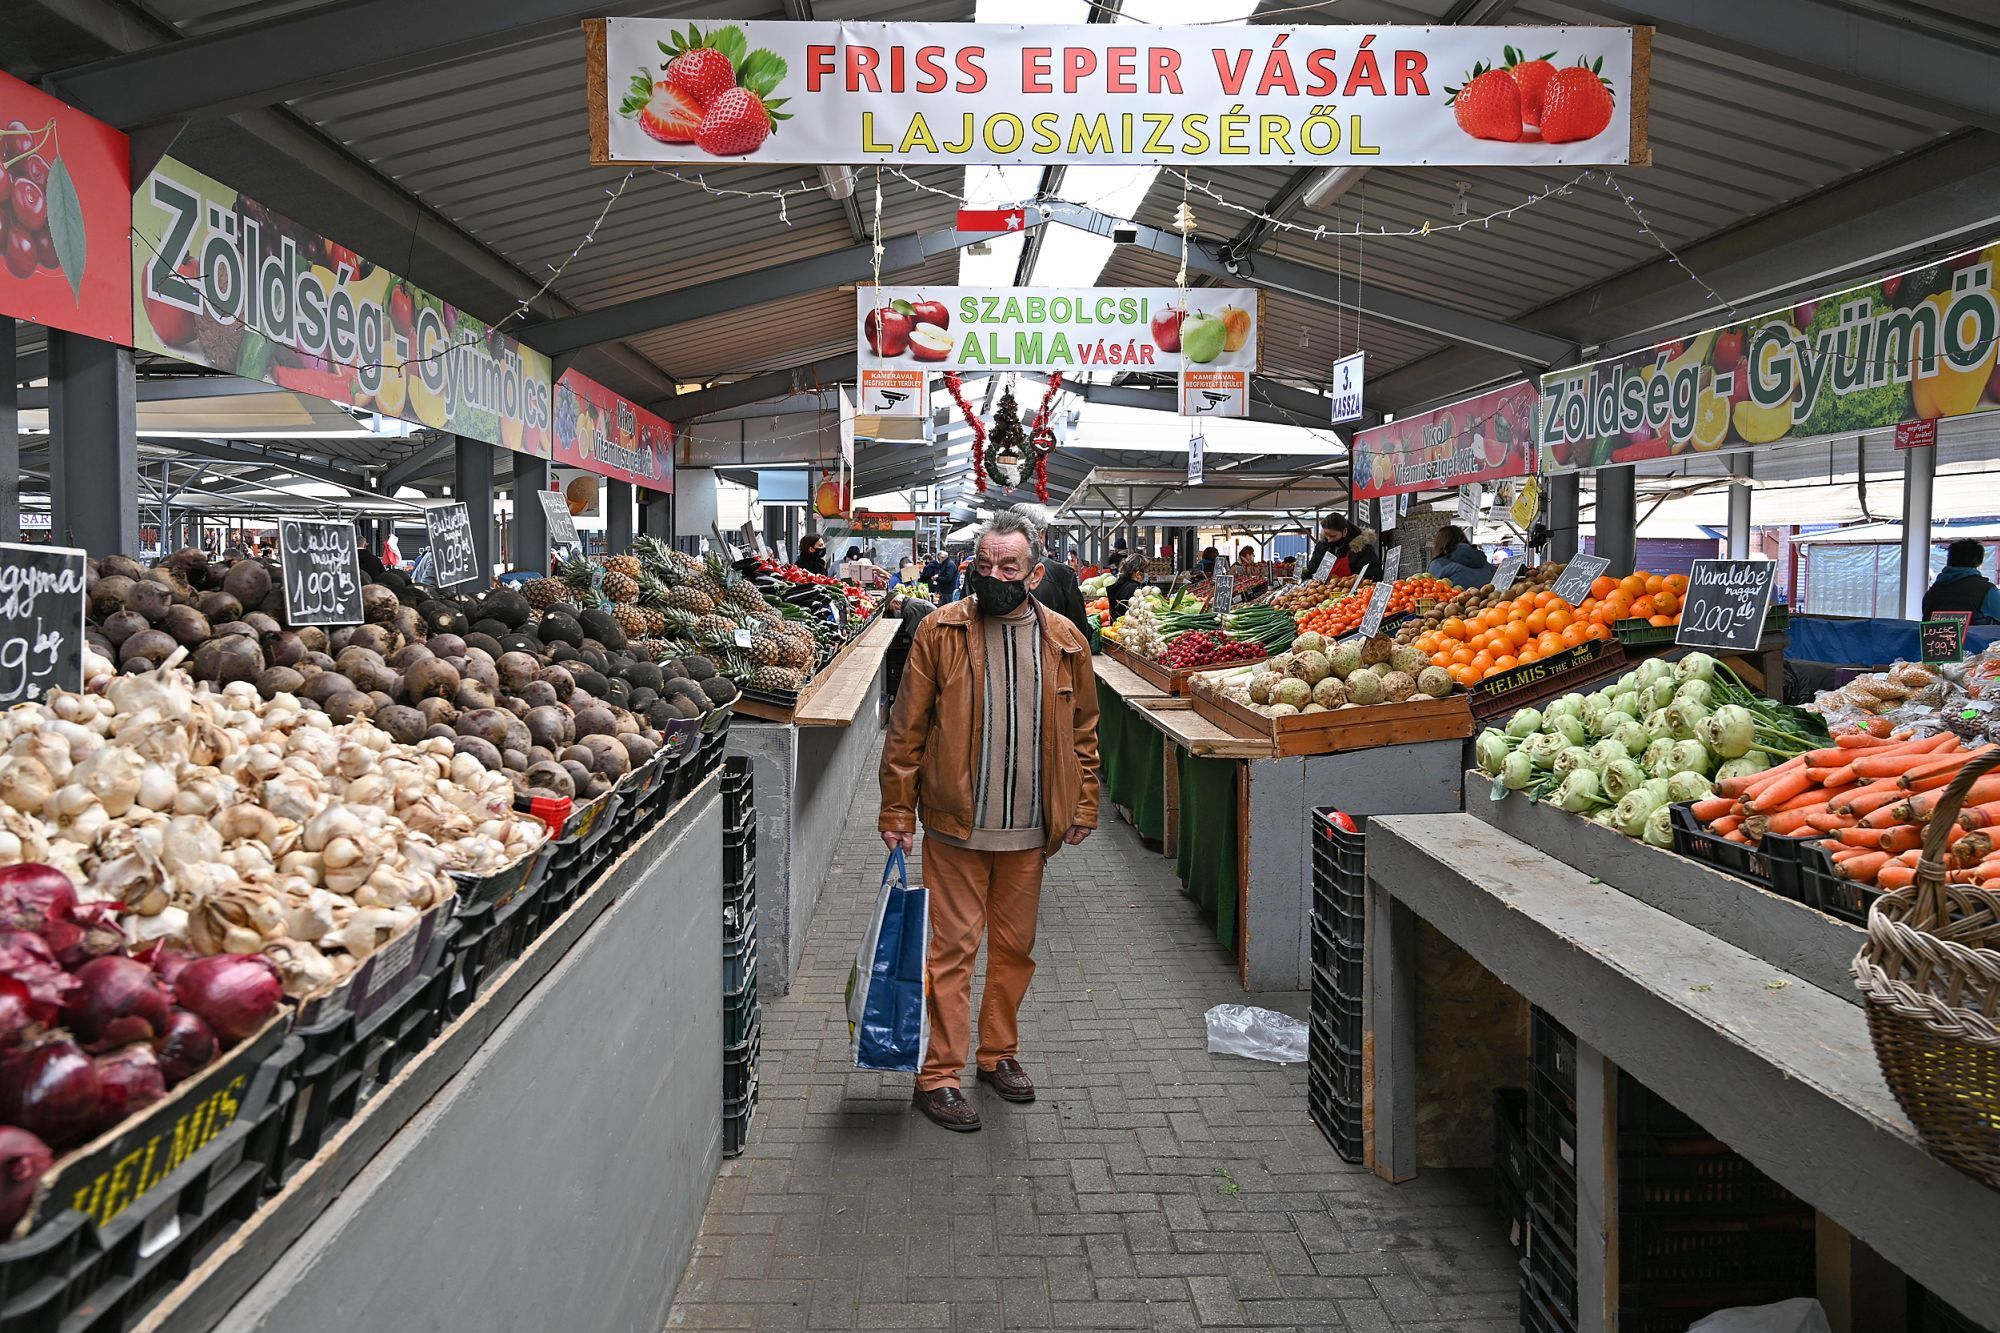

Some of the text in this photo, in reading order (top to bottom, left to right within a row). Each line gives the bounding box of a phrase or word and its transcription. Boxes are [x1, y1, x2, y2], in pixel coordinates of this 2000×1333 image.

[806, 34, 1430, 96] FRISS EPER VÁSÁR
[862, 104, 1380, 155] LAJOSMIZSÉRŐL
[147, 173, 383, 396] Zöldség
[417, 306, 549, 431] Gyümölcs
[959, 296, 1148, 324] SZABOLCSI
[957, 332, 1155, 365] ALMA VÁSÁR
[1543, 349, 1701, 448] Zöldség
[1748, 261, 2000, 425] Gyümö
[1343, 366, 1352, 391] 3.
[1332, 393, 1361, 419] KASSZA
[1422, 419, 1449, 448] Nikol
[1393, 449, 1457, 487] Vitaminsziget
[1484, 653, 1593, 695] HELMIS THE KING
[73, 1075, 246, 1229] HELMIS
